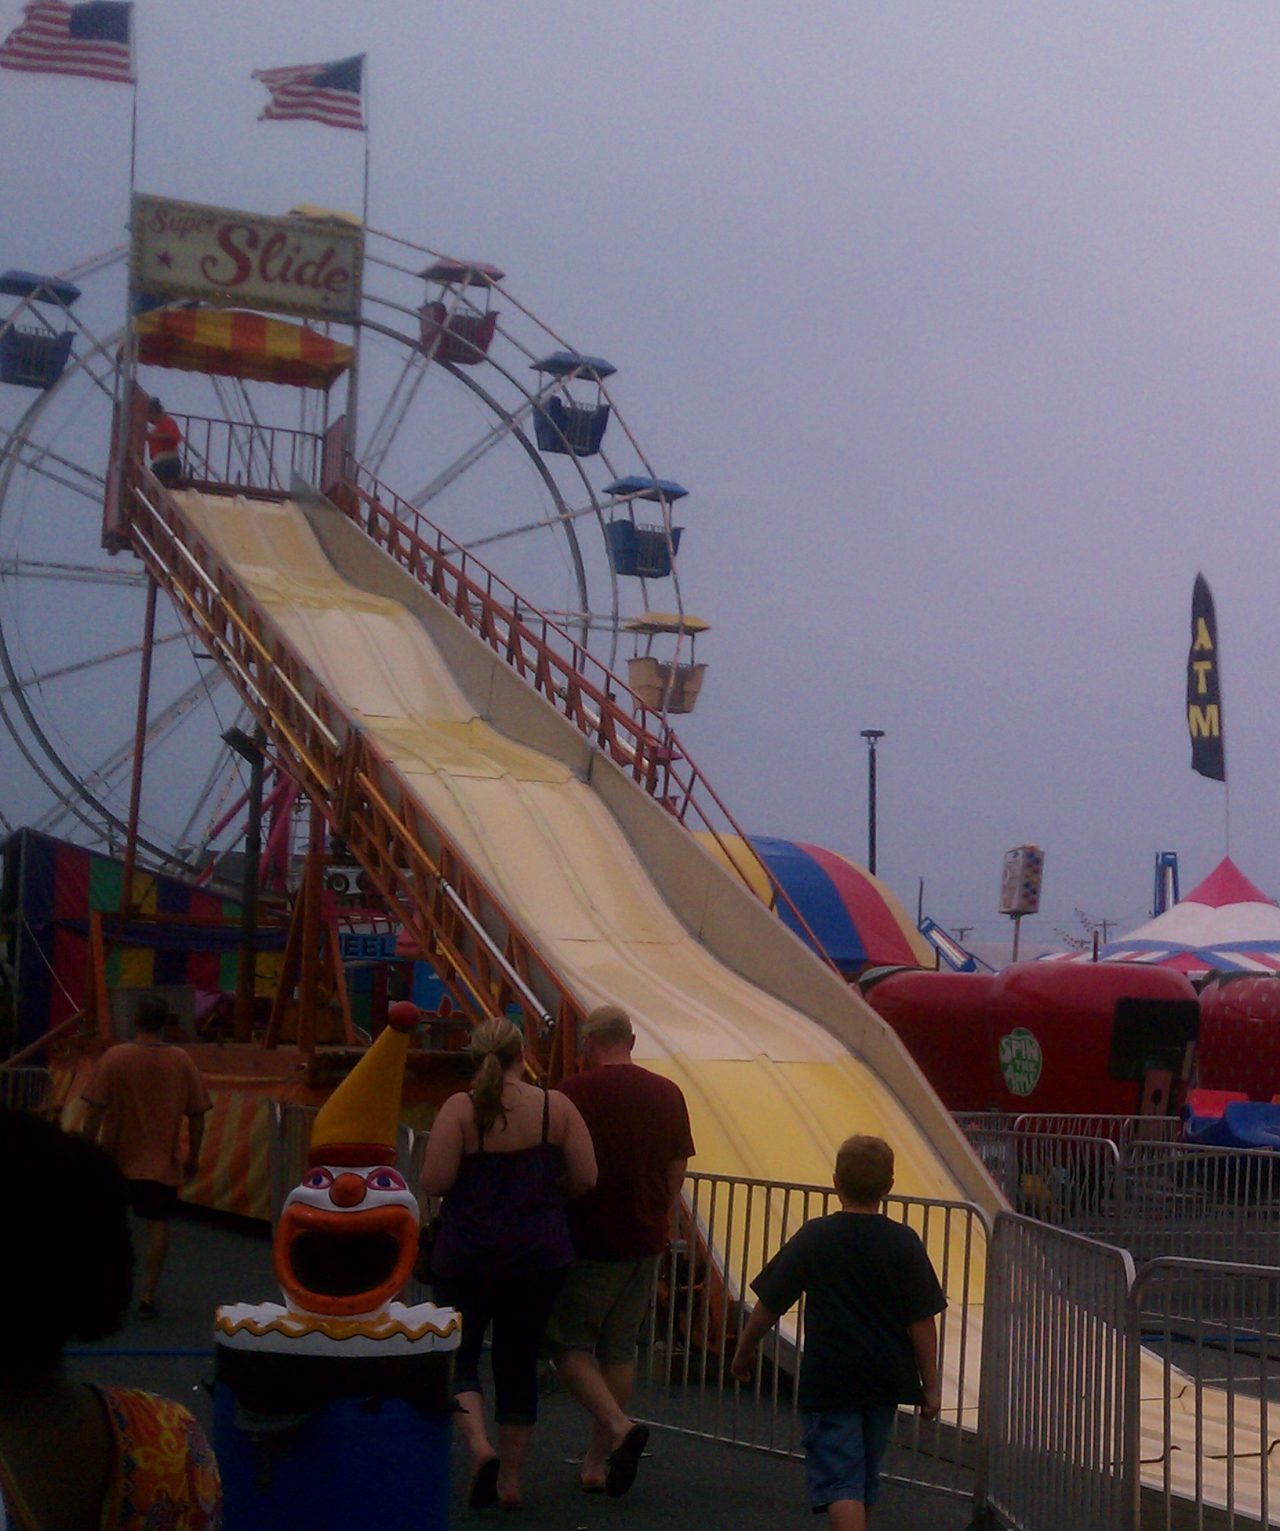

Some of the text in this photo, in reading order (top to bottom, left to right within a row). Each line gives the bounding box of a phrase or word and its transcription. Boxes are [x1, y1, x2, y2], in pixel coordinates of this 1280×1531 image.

[148, 207, 217, 240] Super
[201, 223, 350, 293] Slide
[1188, 616, 1220, 738] ATM
[1000, 1037, 1040, 1063] SPIN
[1014, 1059, 1038, 1073] THE
